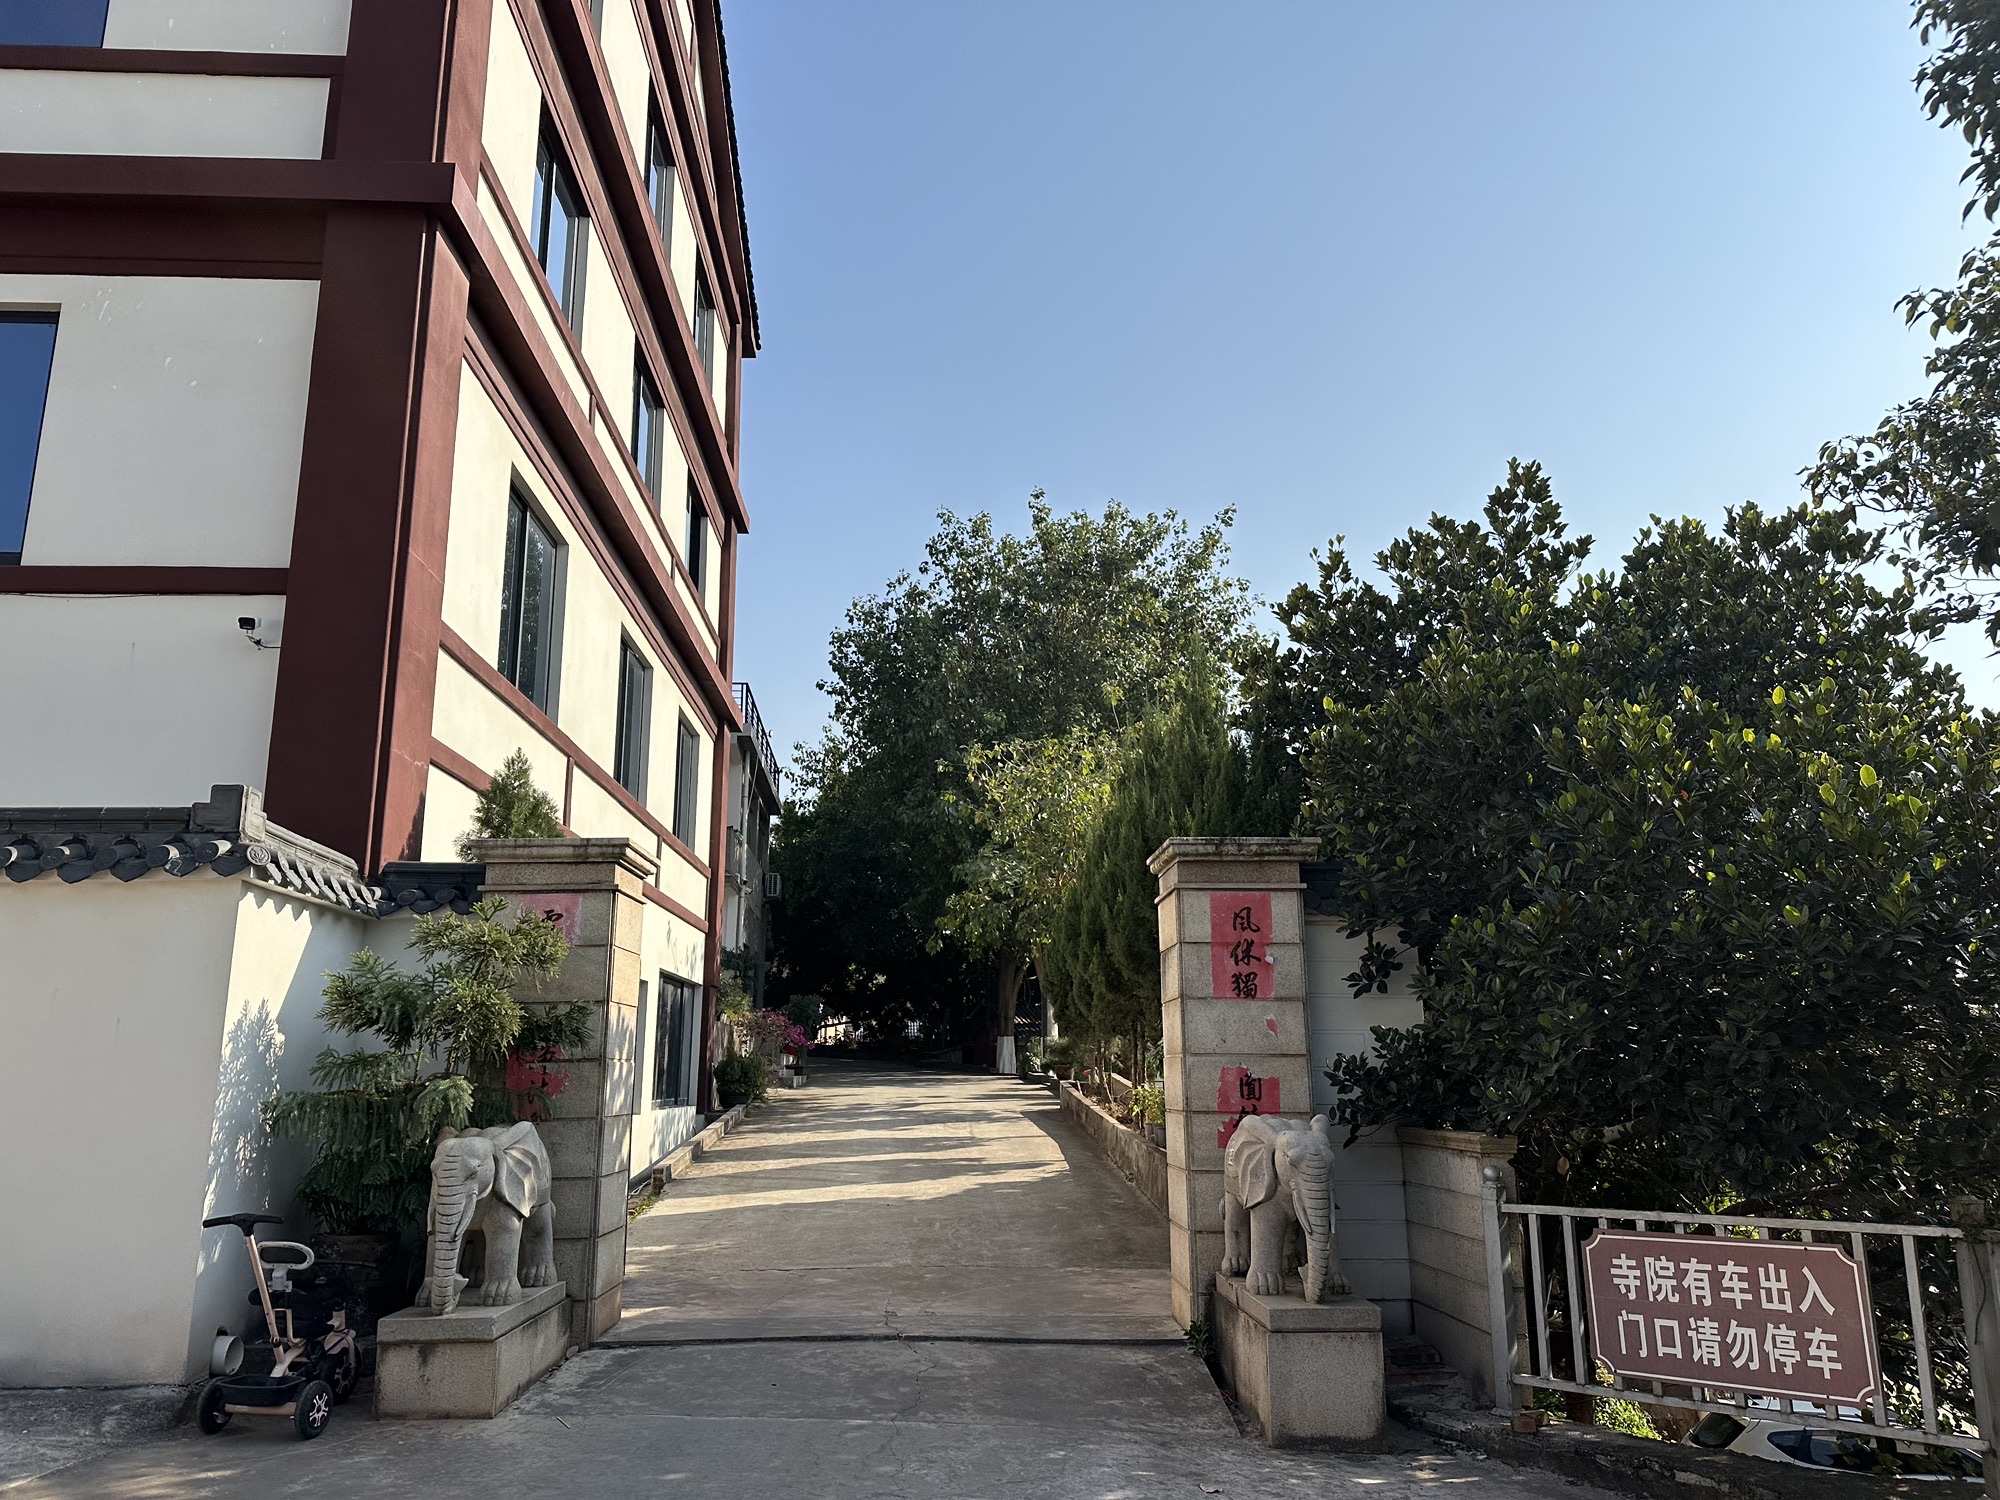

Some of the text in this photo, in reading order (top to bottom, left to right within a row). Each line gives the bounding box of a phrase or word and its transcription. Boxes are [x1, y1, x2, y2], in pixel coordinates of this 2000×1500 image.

[1610, 1253, 1836, 1316] 寺院有车出入
[1617, 1309, 1843, 1380] 门口请勿停车
